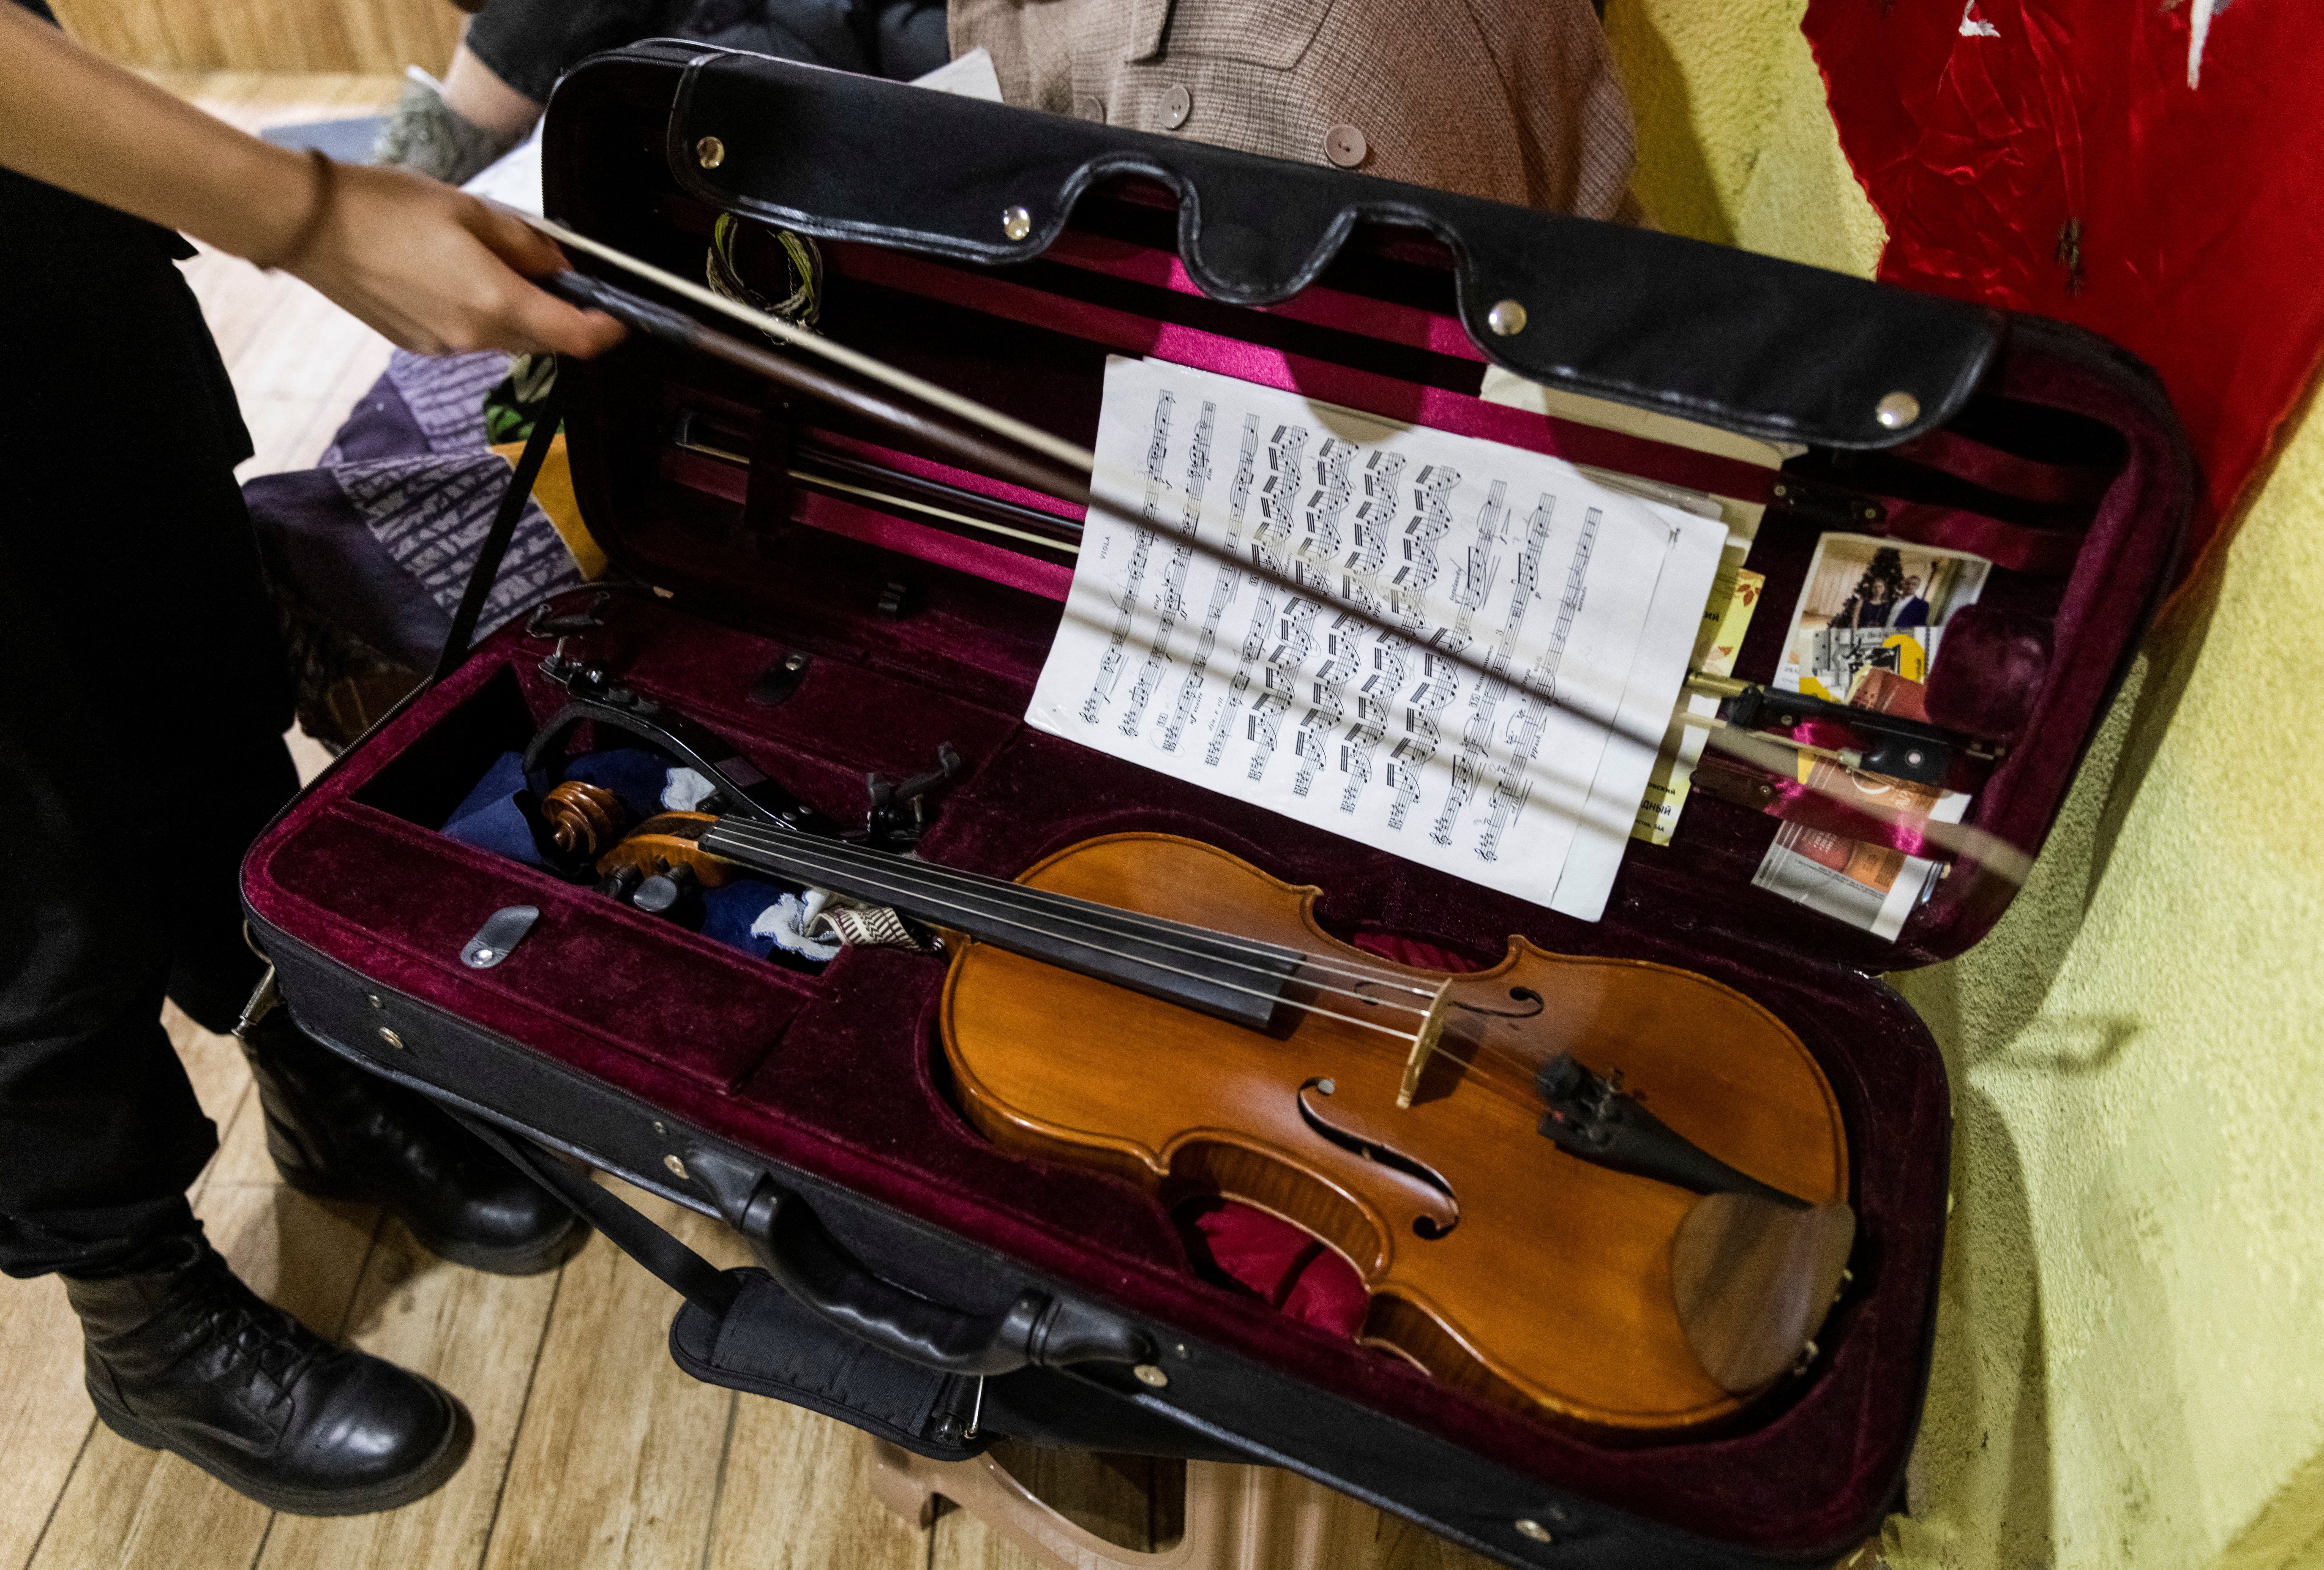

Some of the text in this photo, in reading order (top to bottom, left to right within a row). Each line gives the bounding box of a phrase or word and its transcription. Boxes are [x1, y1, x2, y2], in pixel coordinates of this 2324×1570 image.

[1163, 480, 1173, 489] mf
[1100, 536, 1110, 559] VIOLA
[1250, 575, 1259, 585] 14
[1280, 552, 1292, 593] pp calmato
[1449, 567, 1462, 601] incalzando
[1535, 592, 1541, 600] p
[1577, 587, 1587, 612] morendo
[1180, 609, 1187, 620] ff
[1372, 601, 1382, 619] ppp
[1473, 646, 1494, 707] 15 Meno mosso
[1520, 669, 1531, 688] tempo
[1190, 692, 1203, 724] mf sonore
[1157, 715, 1168, 725] 13
[1530, 746, 1538, 759] pp
[1511, 792, 1522, 814] ad lib.
